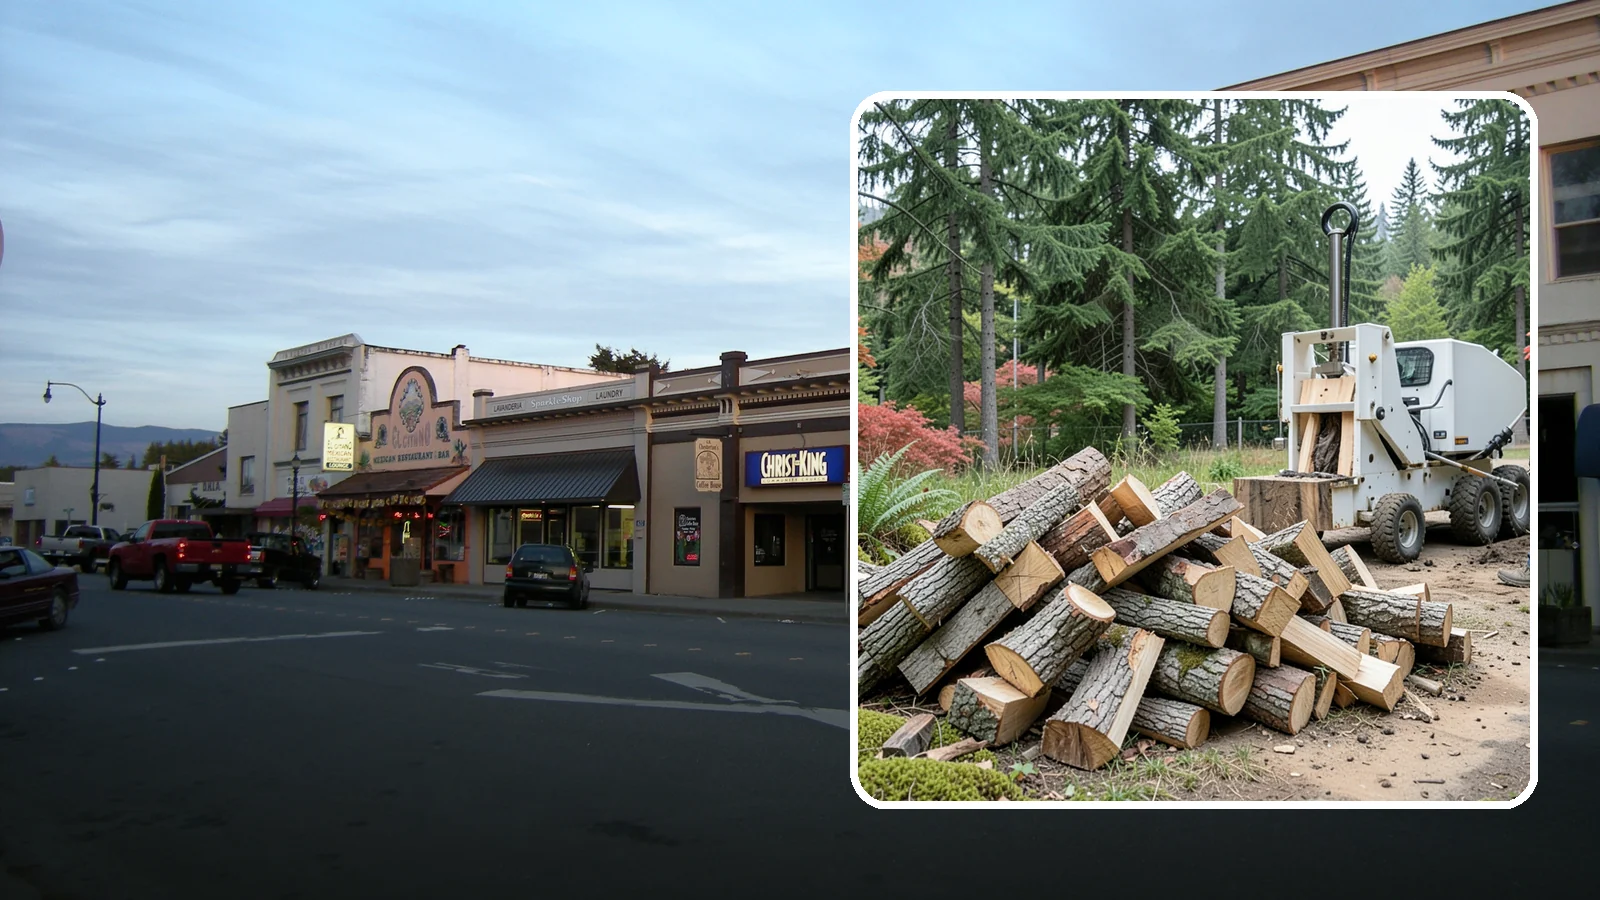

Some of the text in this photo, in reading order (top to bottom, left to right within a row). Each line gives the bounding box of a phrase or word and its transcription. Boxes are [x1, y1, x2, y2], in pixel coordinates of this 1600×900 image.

[595, 389, 623, 399] LAUNDRY
[493, 402, 523, 412] LAVANDERIA
[531, 394, 582, 408] Sparkle Shop
[373, 455, 396, 464] MEXICAN
[397, 451, 433, 462] RESTAURANT
[438, 450, 450, 459] BAR
[761, 452, 797, 478] CHRIST
[799, 450, 827, 476] KING
[696, 480, 722, 489] Coffee House
